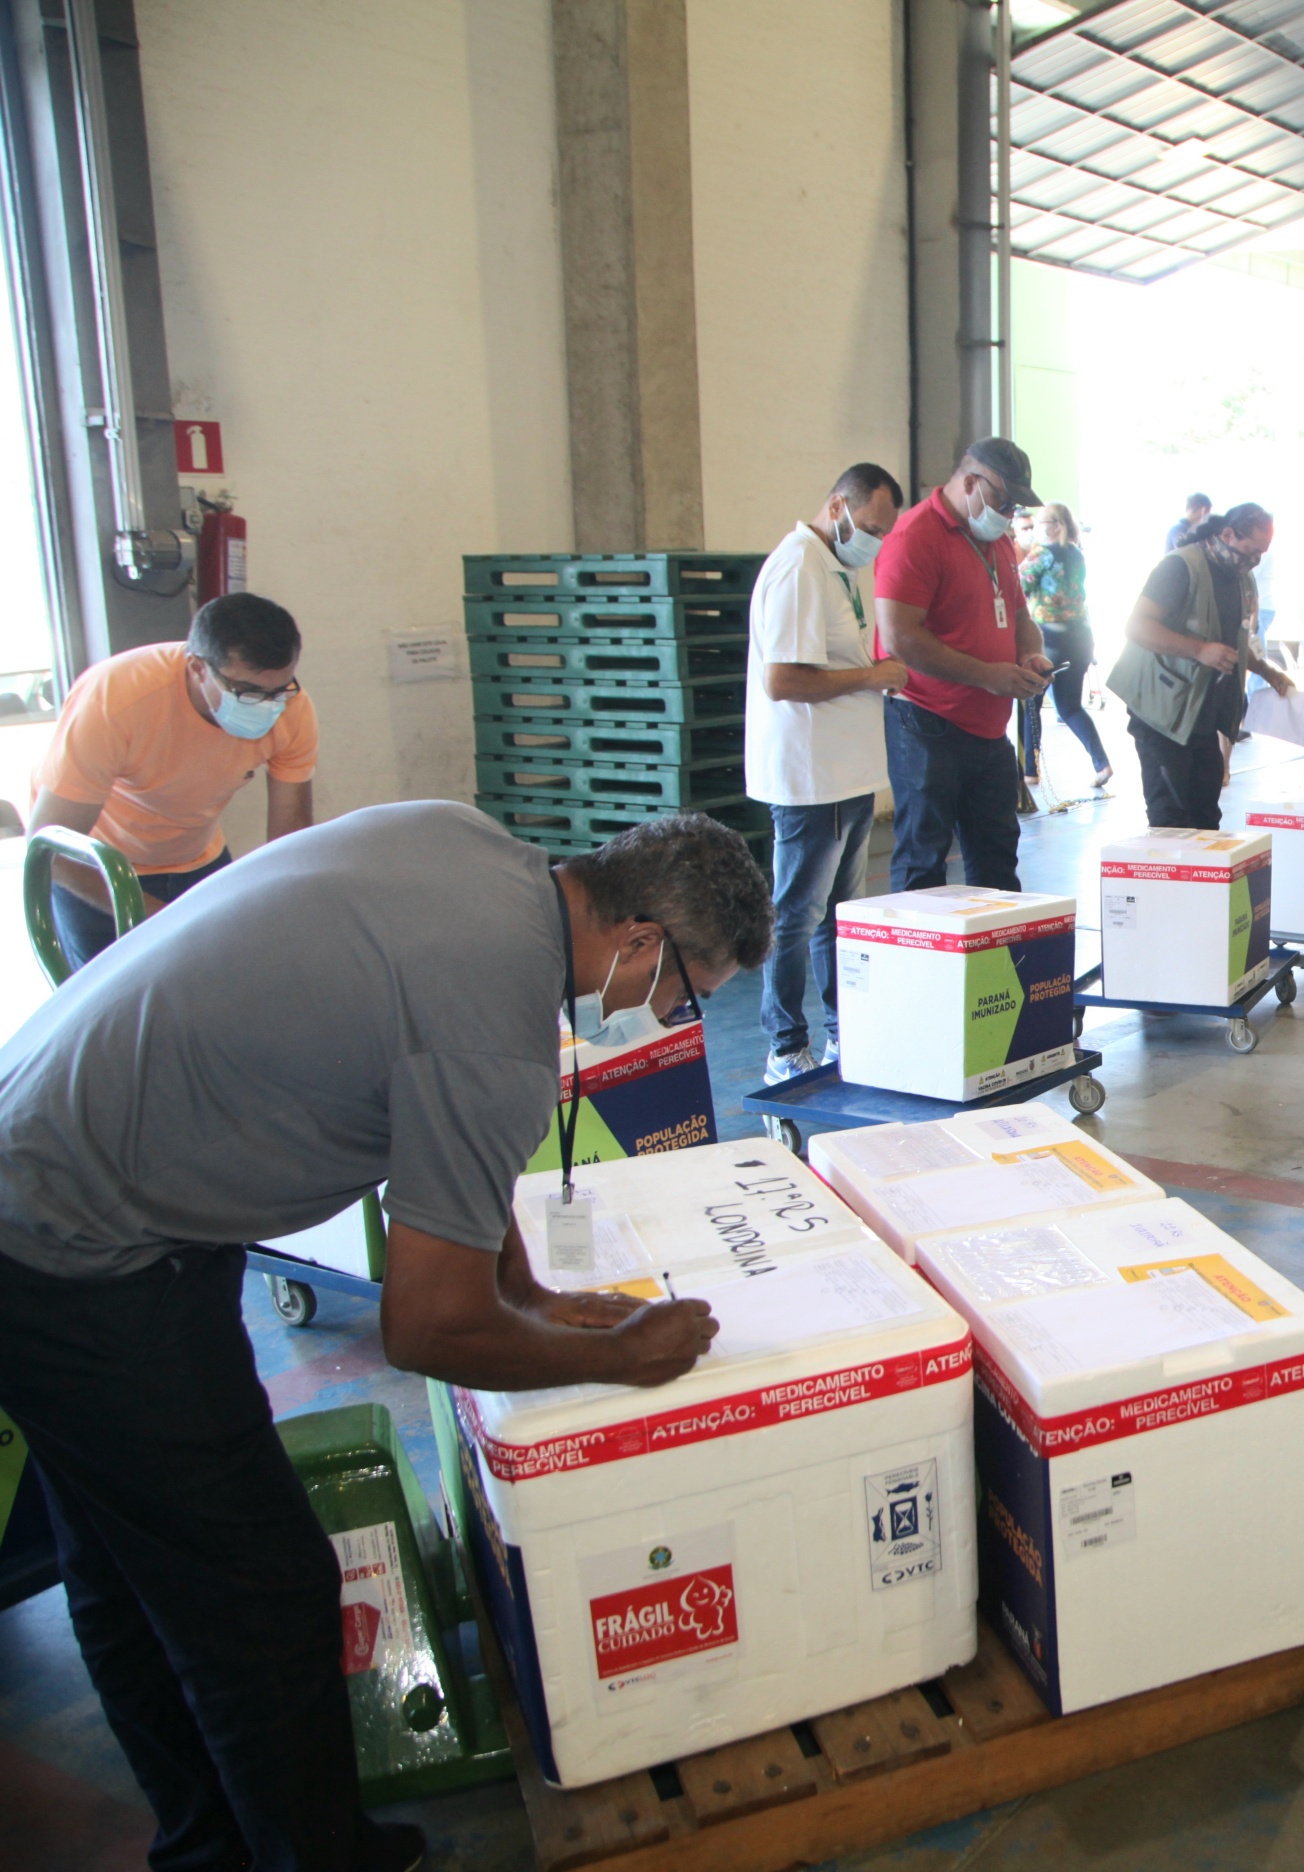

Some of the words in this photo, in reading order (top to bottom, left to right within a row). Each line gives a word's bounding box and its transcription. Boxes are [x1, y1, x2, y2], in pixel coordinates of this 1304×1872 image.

[1127, 864, 1177, 873] MEDICAMENTO
[851, 927, 889, 940] ATENÇÃO:
[891, 928, 941, 942] MEDICAMENTO
[897, 936, 935, 949] PERECÍVEL
[978, 988, 1010, 1008] PARANÁ
[1030, 973, 1071, 993] POPULAÇÃO
[1030, 984, 1071, 1003] PROTEGIDA
[971, 1000, 1017, 1021] IMUNIZADO
[602, 1059, 649, 1082] ATENÇÃO:
[650, 1035, 705, 1060] MEDICAMENTO
[658, 1047, 701, 1067] PERECÍVEL
[635, 1114, 707, 1150] POPULAÇÃO
[704, 1202, 778, 1278] LONDRINA
[1215, 1275, 1252, 1303] ATENÇÃO
[761, 1364, 884, 1406] MEDICAMENTO
[779, 1385, 871, 1418] PERECÍVEL
[1120, 1377, 1232, 1418] MEDICAMENTO
[652, 1403, 756, 1441] ATENÇÃO:
[1135, 1397, 1219, 1430] PERECÍVEL
[1033, 1415, 1116, 1448] ATENÇÃO:
[596, 1601, 674, 1640] FRÁGIL
[598, 1622, 676, 1655] CUIDADO
